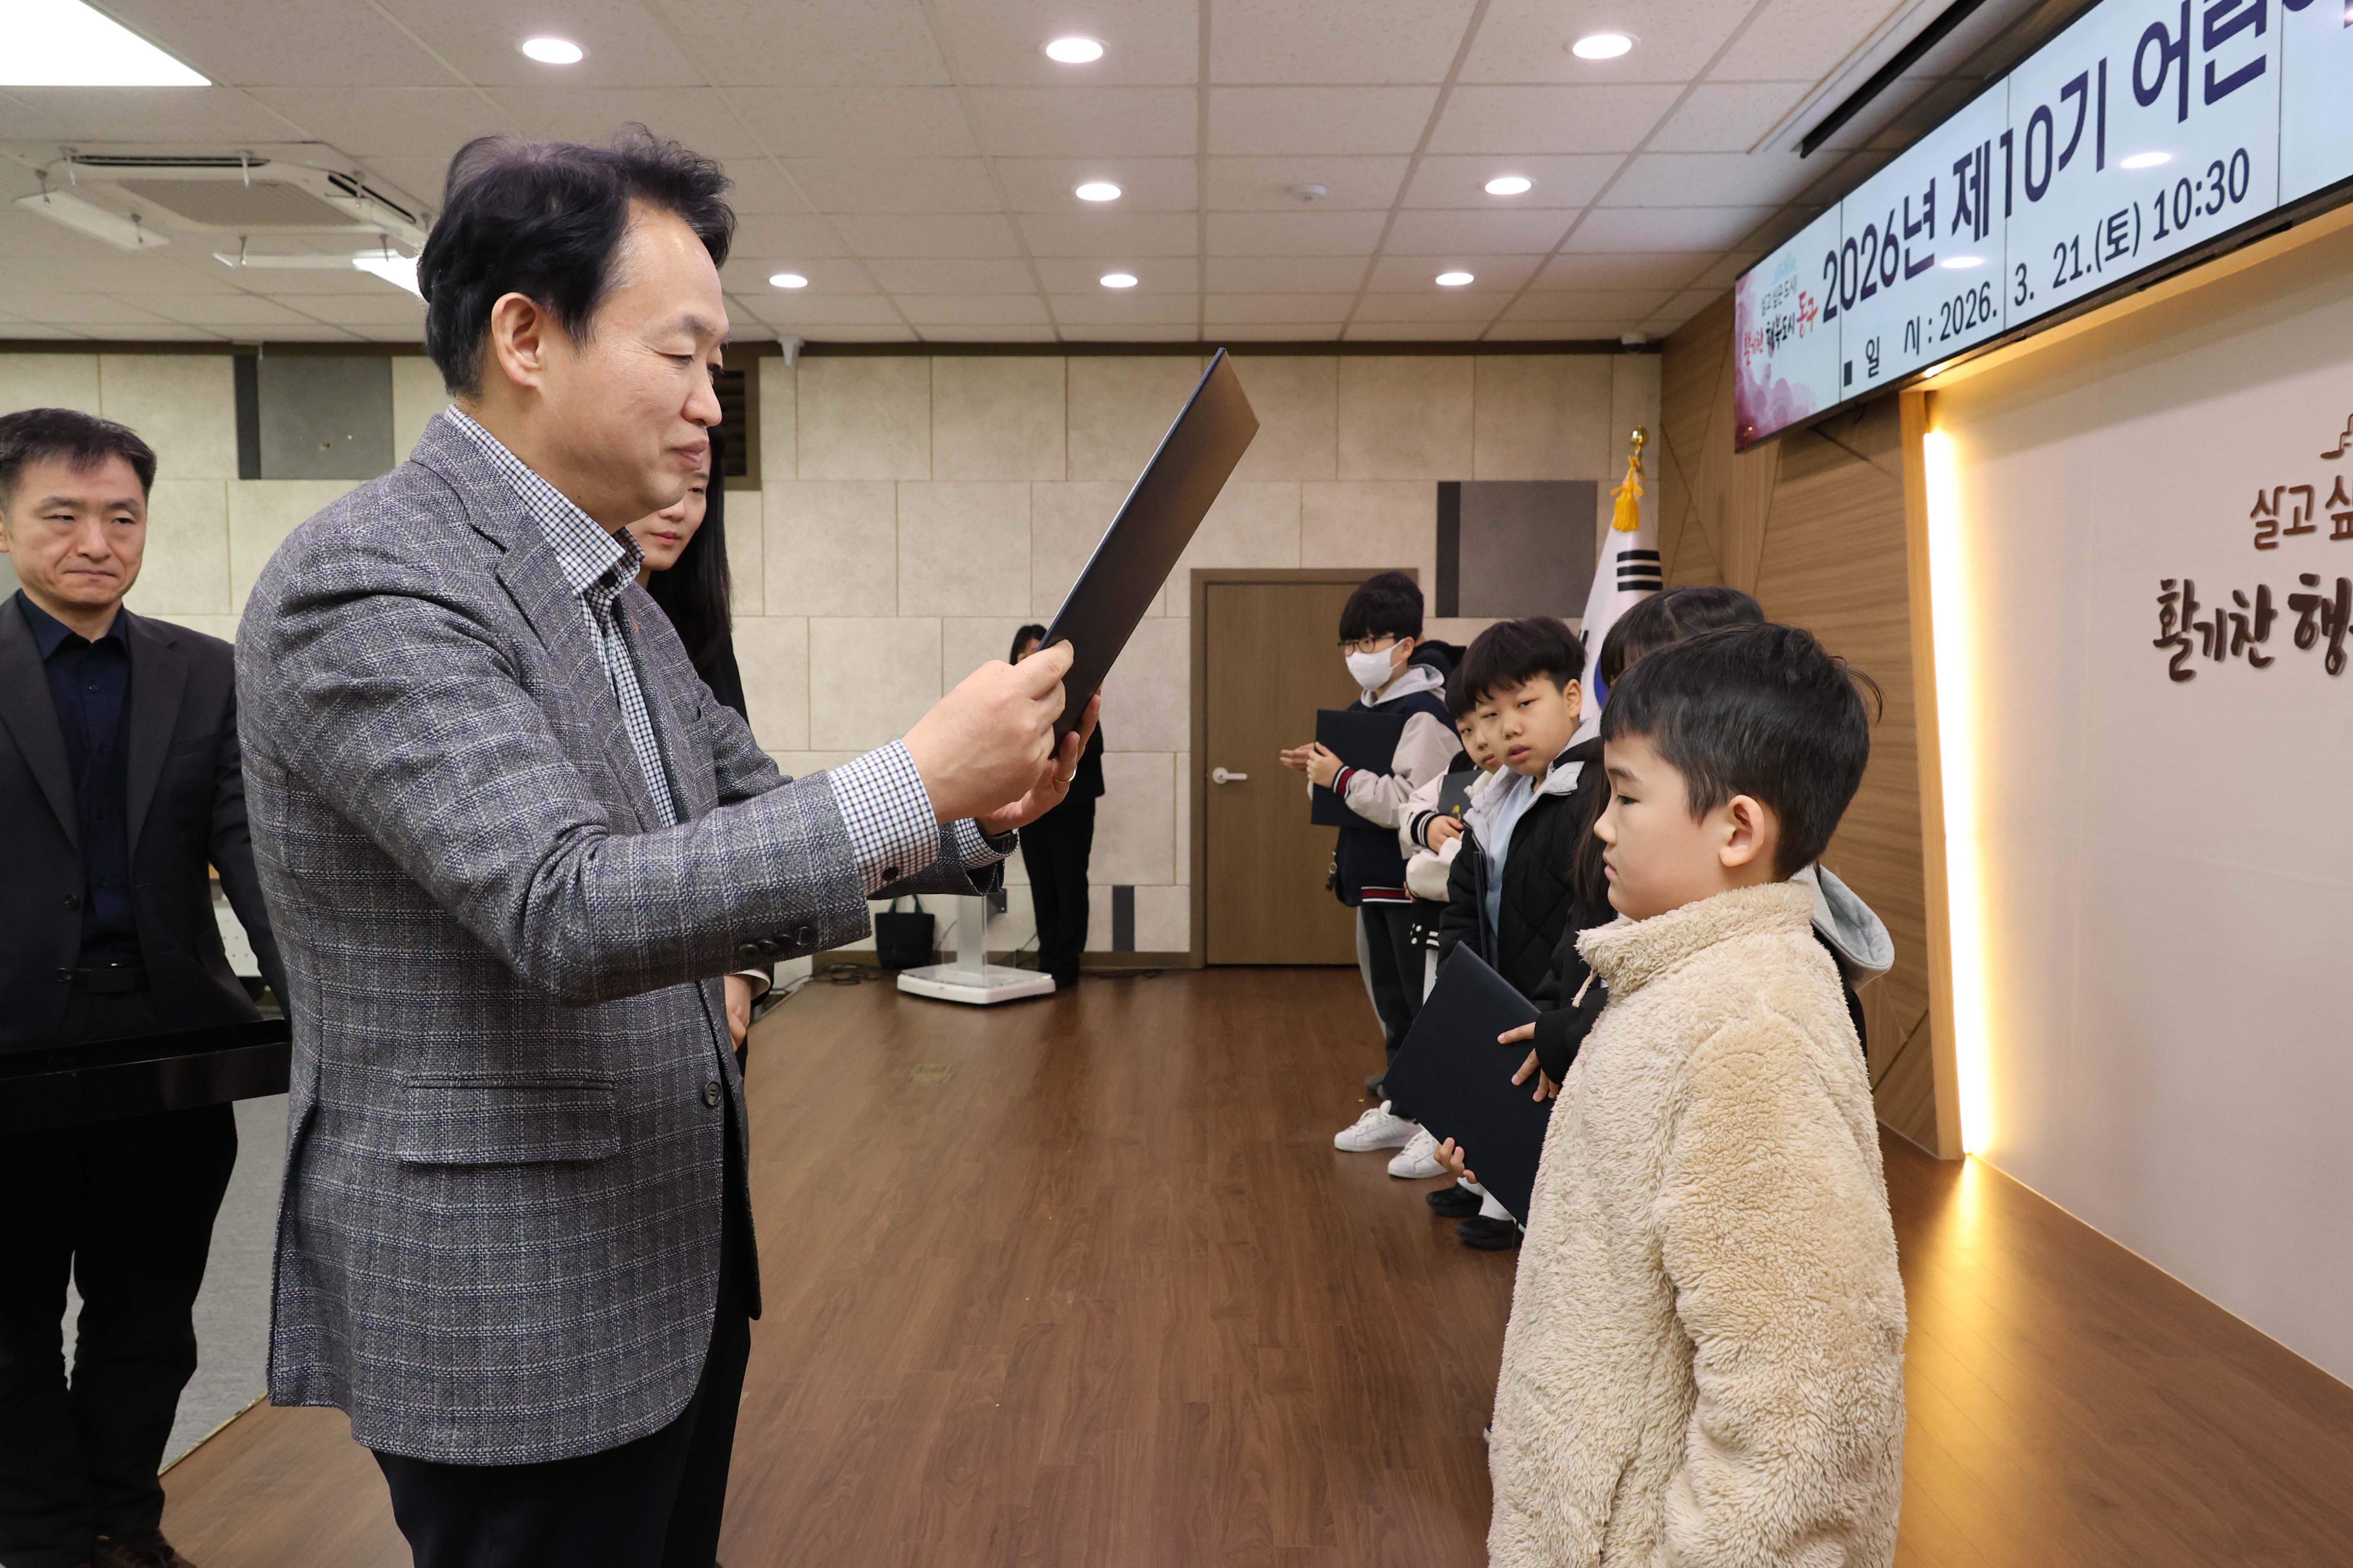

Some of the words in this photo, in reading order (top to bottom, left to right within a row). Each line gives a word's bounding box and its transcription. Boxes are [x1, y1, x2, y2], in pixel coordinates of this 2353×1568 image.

[1823, 177, 1935, 323] 2026년
[1952, 57, 2107, 242] 제10기
[2132, 0, 2353, 124] 어린
[1940, 281, 1997, 341] 2026.
[2014, 262, 2034, 306] 3.
[2153, 147, 2250, 242] 10:30
[1797, 290, 1818, 338] 동구
[2250, 485, 2318, 550] 살고
[2153, 578, 2278, 682] 활기찬
[2287, 573, 2353, 676] 행
